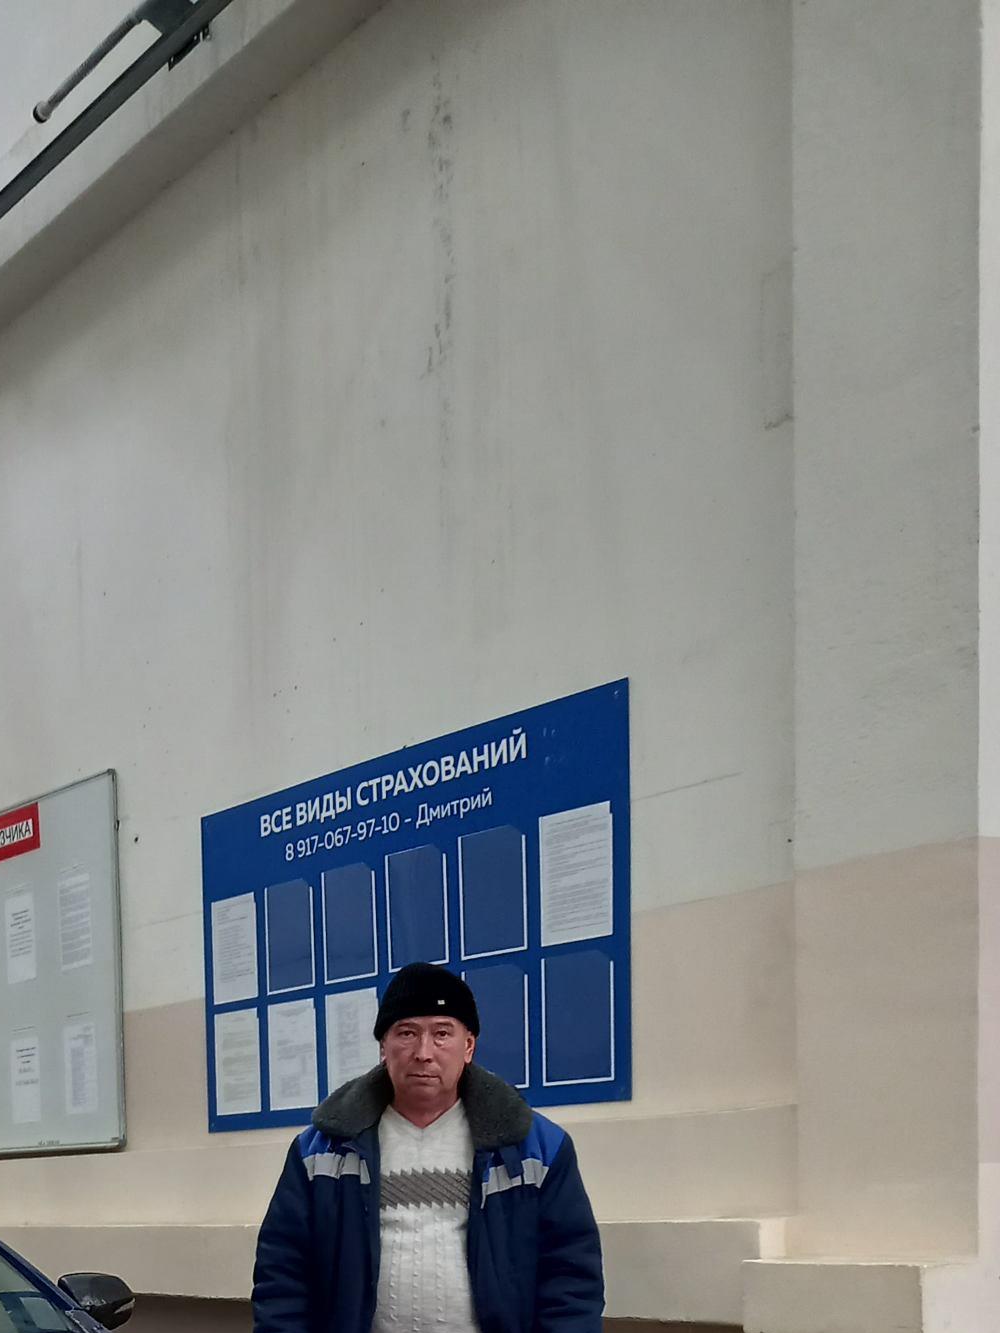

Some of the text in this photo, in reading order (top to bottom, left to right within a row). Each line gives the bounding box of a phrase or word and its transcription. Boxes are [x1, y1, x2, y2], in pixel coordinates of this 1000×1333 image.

[259, 727, 527, 837] ВСЕ ВИДЫ СТРАХОВАНИЙ
[284, 842, 295, 862] 8
[297, 812, 400, 858] 917-067-97-10
[415, 787, 493, 829] Дмитрий
